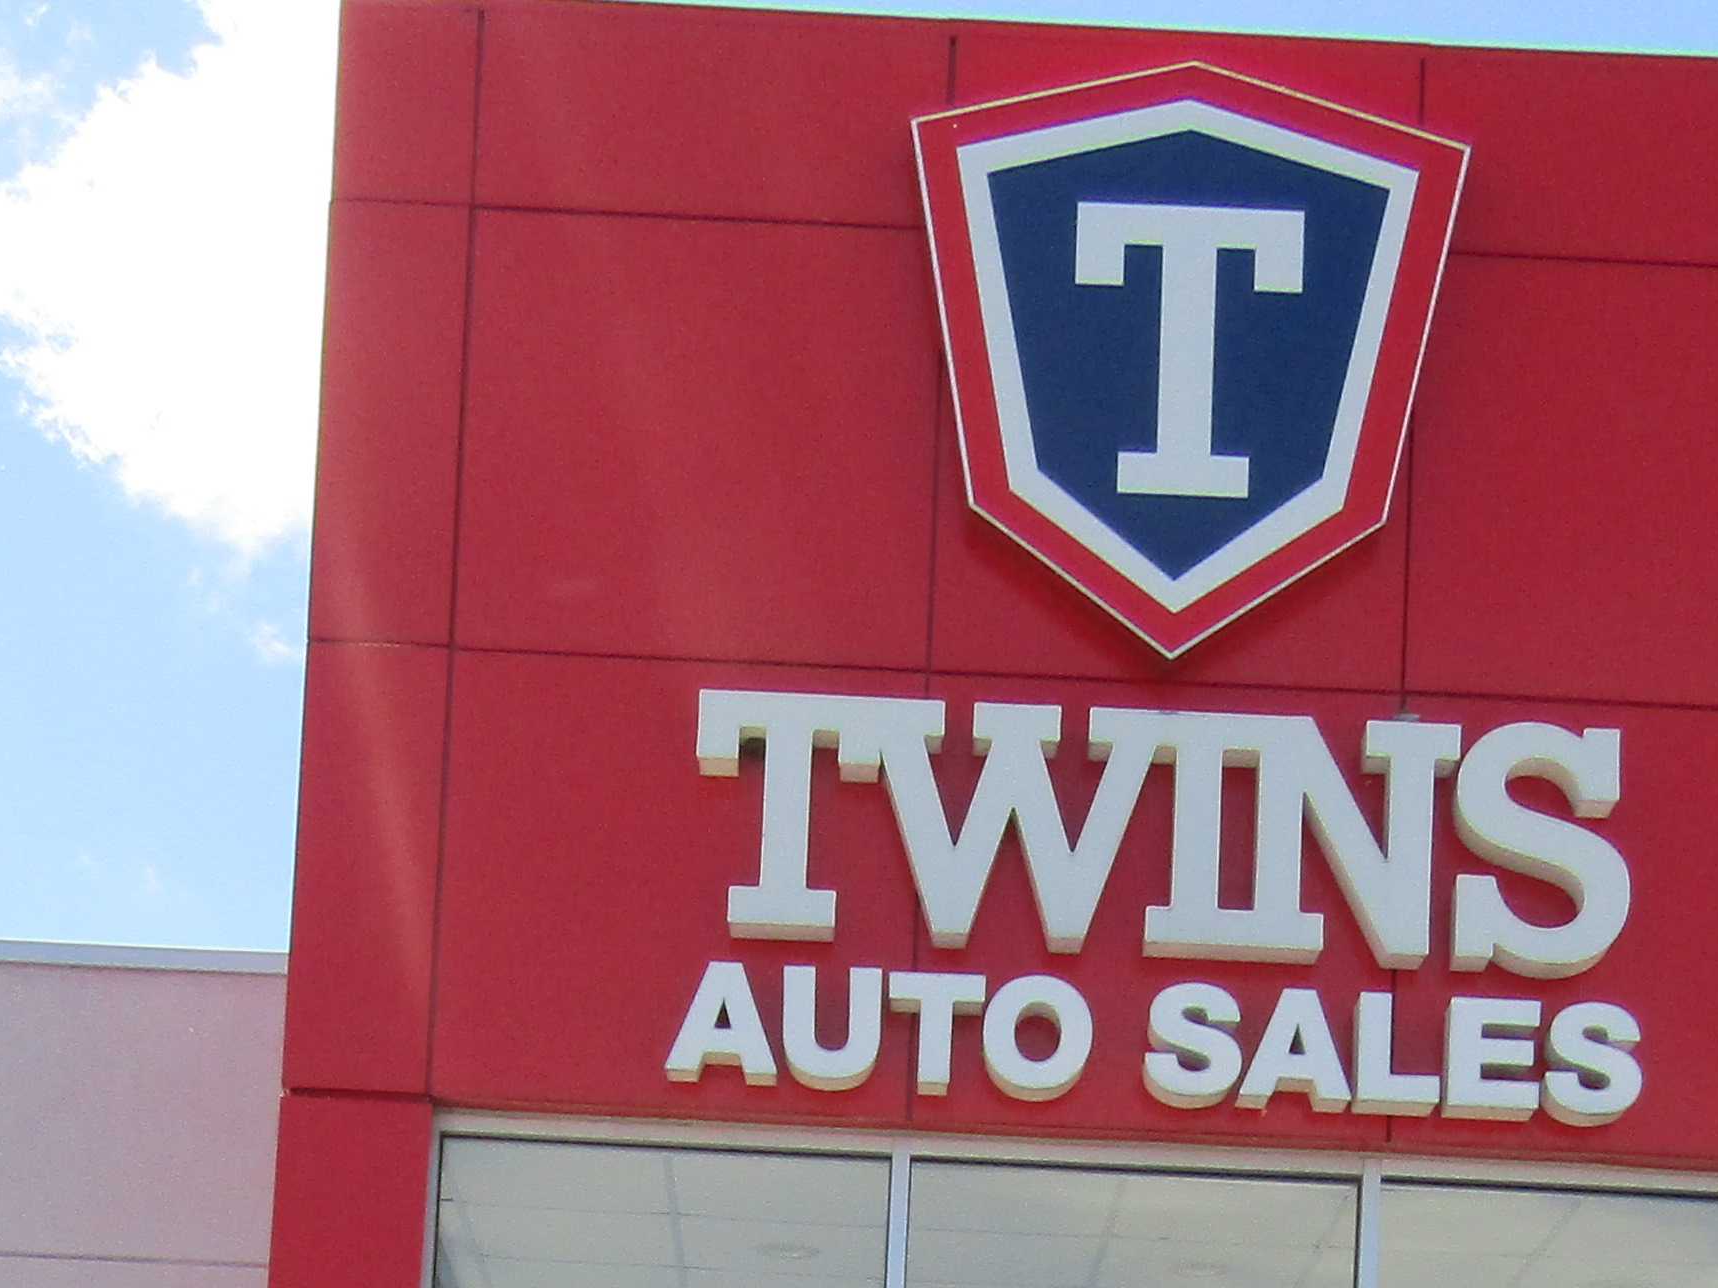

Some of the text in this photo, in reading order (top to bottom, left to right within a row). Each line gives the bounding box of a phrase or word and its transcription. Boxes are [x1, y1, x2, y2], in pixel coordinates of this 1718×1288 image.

[1075, 202, 1304, 499] T
[695, 688, 1630, 980] TWINS
[665, 961, 1642, 1126] AUTO SALES
